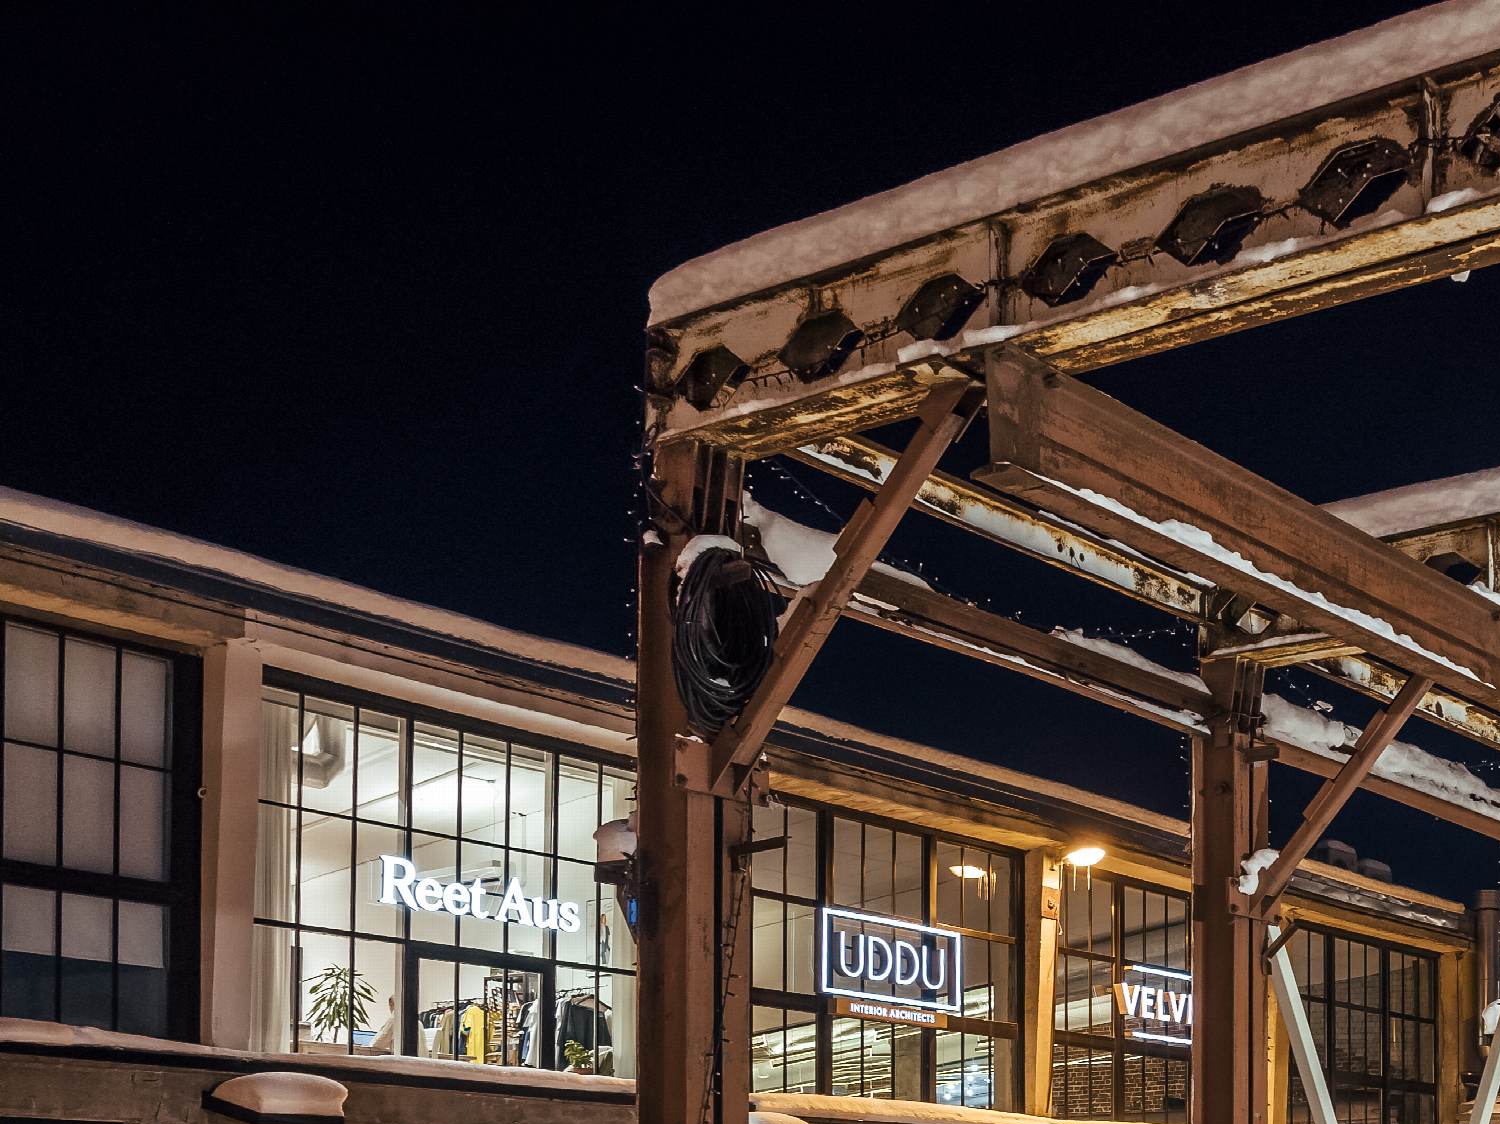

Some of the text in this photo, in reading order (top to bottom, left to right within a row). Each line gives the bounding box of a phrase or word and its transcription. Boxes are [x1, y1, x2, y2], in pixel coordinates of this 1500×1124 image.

[379, 854, 581, 933] Reet Aus
[838, 929, 946, 991] UDDU
[850, 1002, 936, 1024] INTERIOR ARCHITECTS
